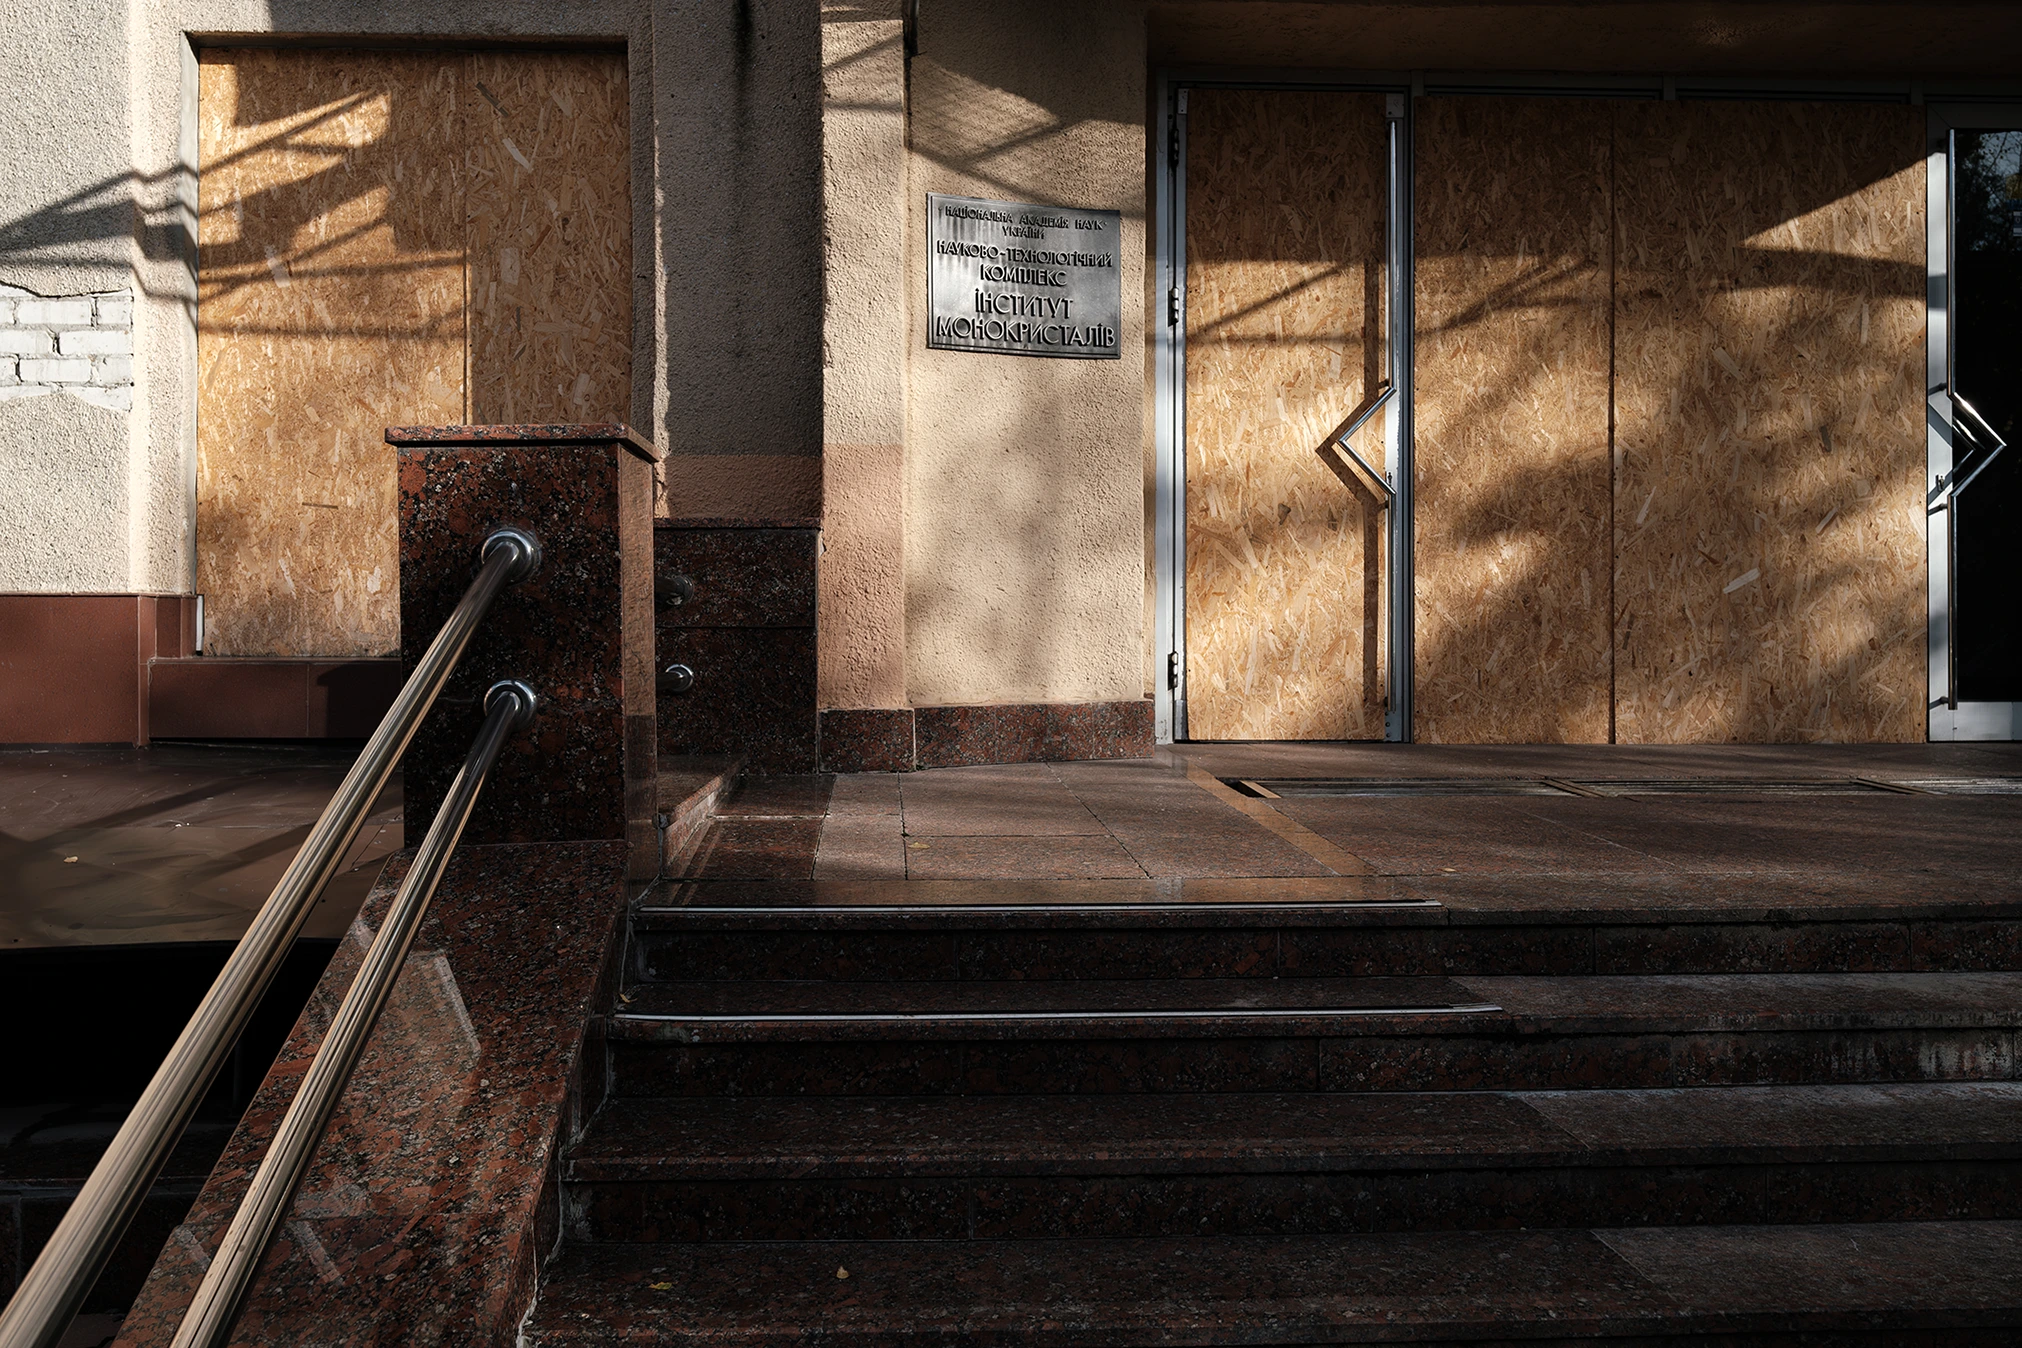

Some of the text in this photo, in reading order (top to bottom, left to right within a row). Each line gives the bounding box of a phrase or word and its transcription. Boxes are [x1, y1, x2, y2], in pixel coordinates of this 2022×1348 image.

[1002, 226, 1045, 240] УКРАЇНИ
[1019, 214, 1069, 229] АКАДЕМІЯ
[1075, 219, 1103, 231] НАУК
[937, 240, 1113, 268] НАУКОВО-ТЕХНОЛОГІЧНИЙ
[980, 263, 1068, 287] КОМПЛЕКС
[975, 288, 1074, 319] ІНСТИТУТ
[937, 316, 1115, 348] МОНОКРИСТАЛІВ
